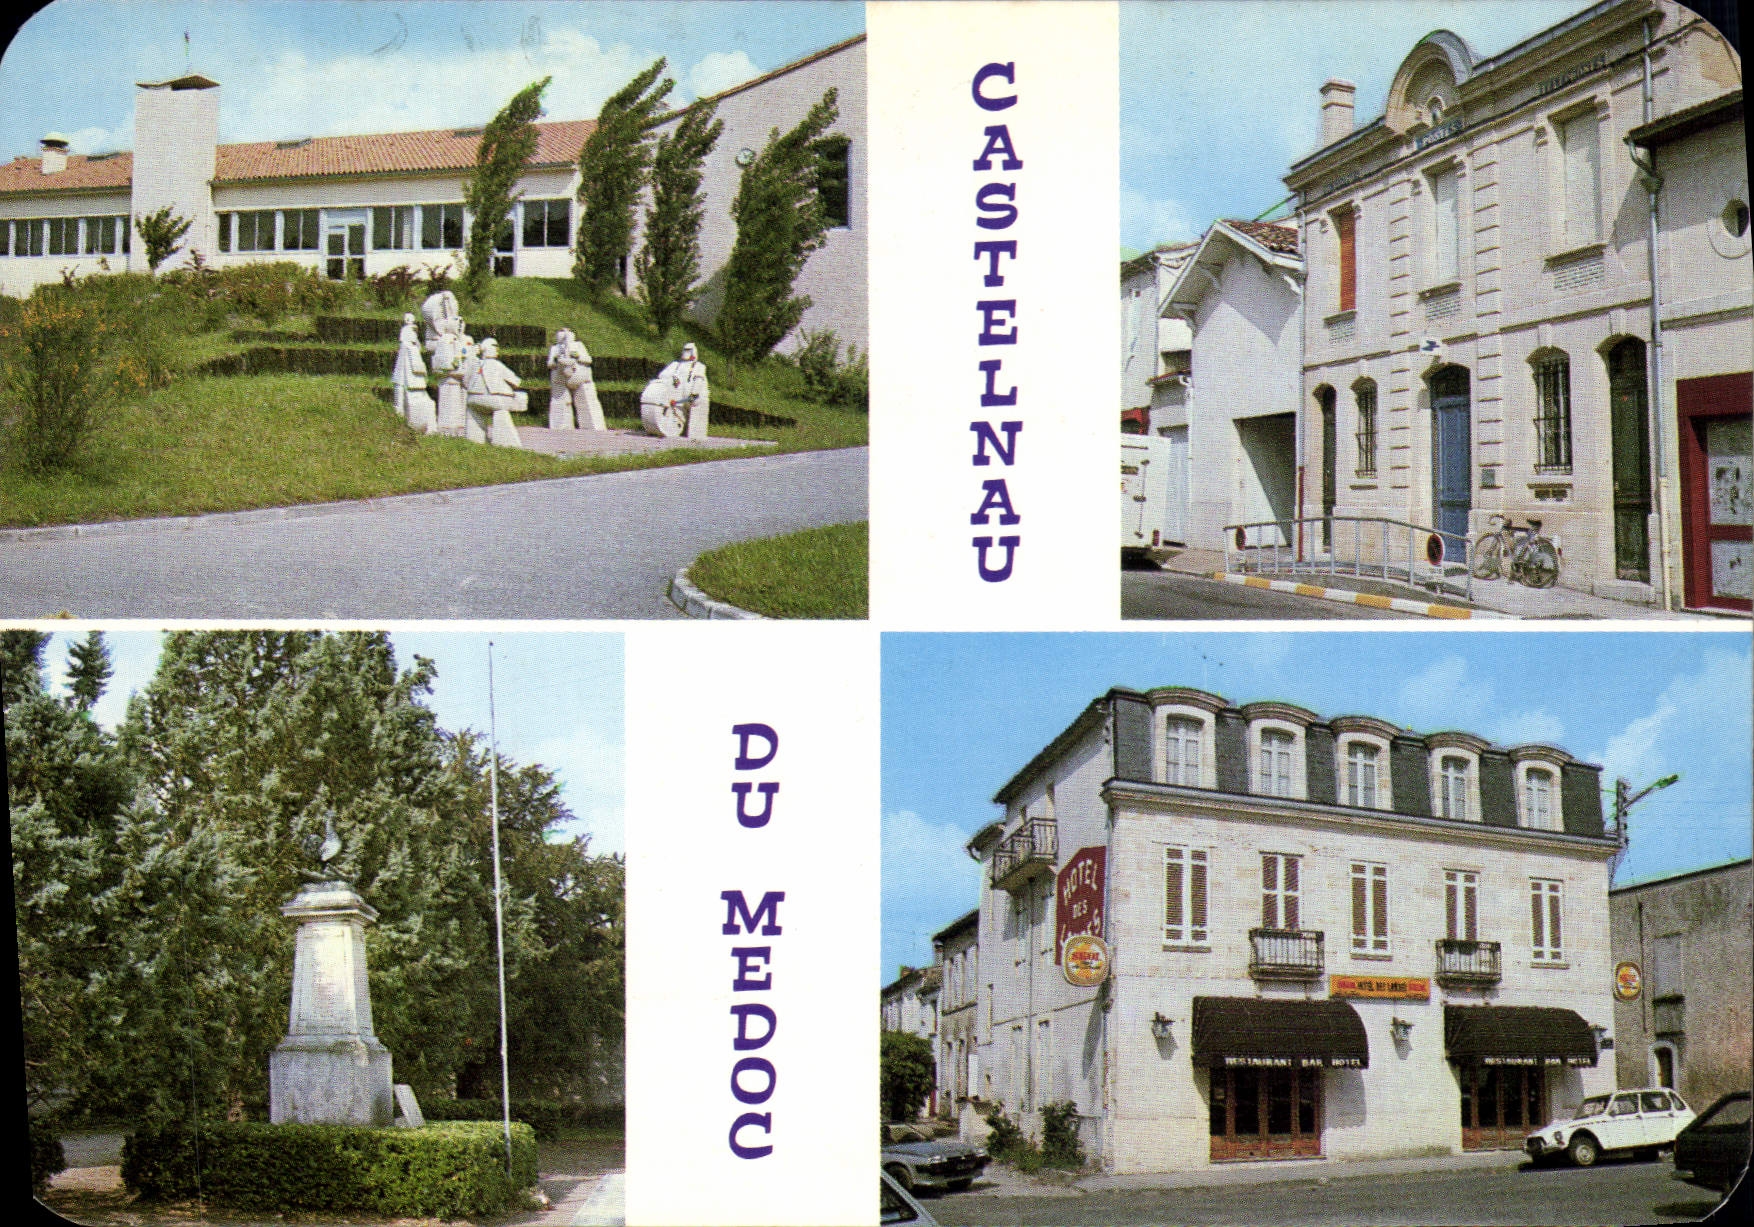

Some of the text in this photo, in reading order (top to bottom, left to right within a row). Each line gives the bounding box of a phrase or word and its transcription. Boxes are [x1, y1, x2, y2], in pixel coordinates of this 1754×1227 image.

[1062, 857, 1099, 907] HOTEL
[1224, 1056, 1361, 1068] RESTAURANT BAR HOTEL
